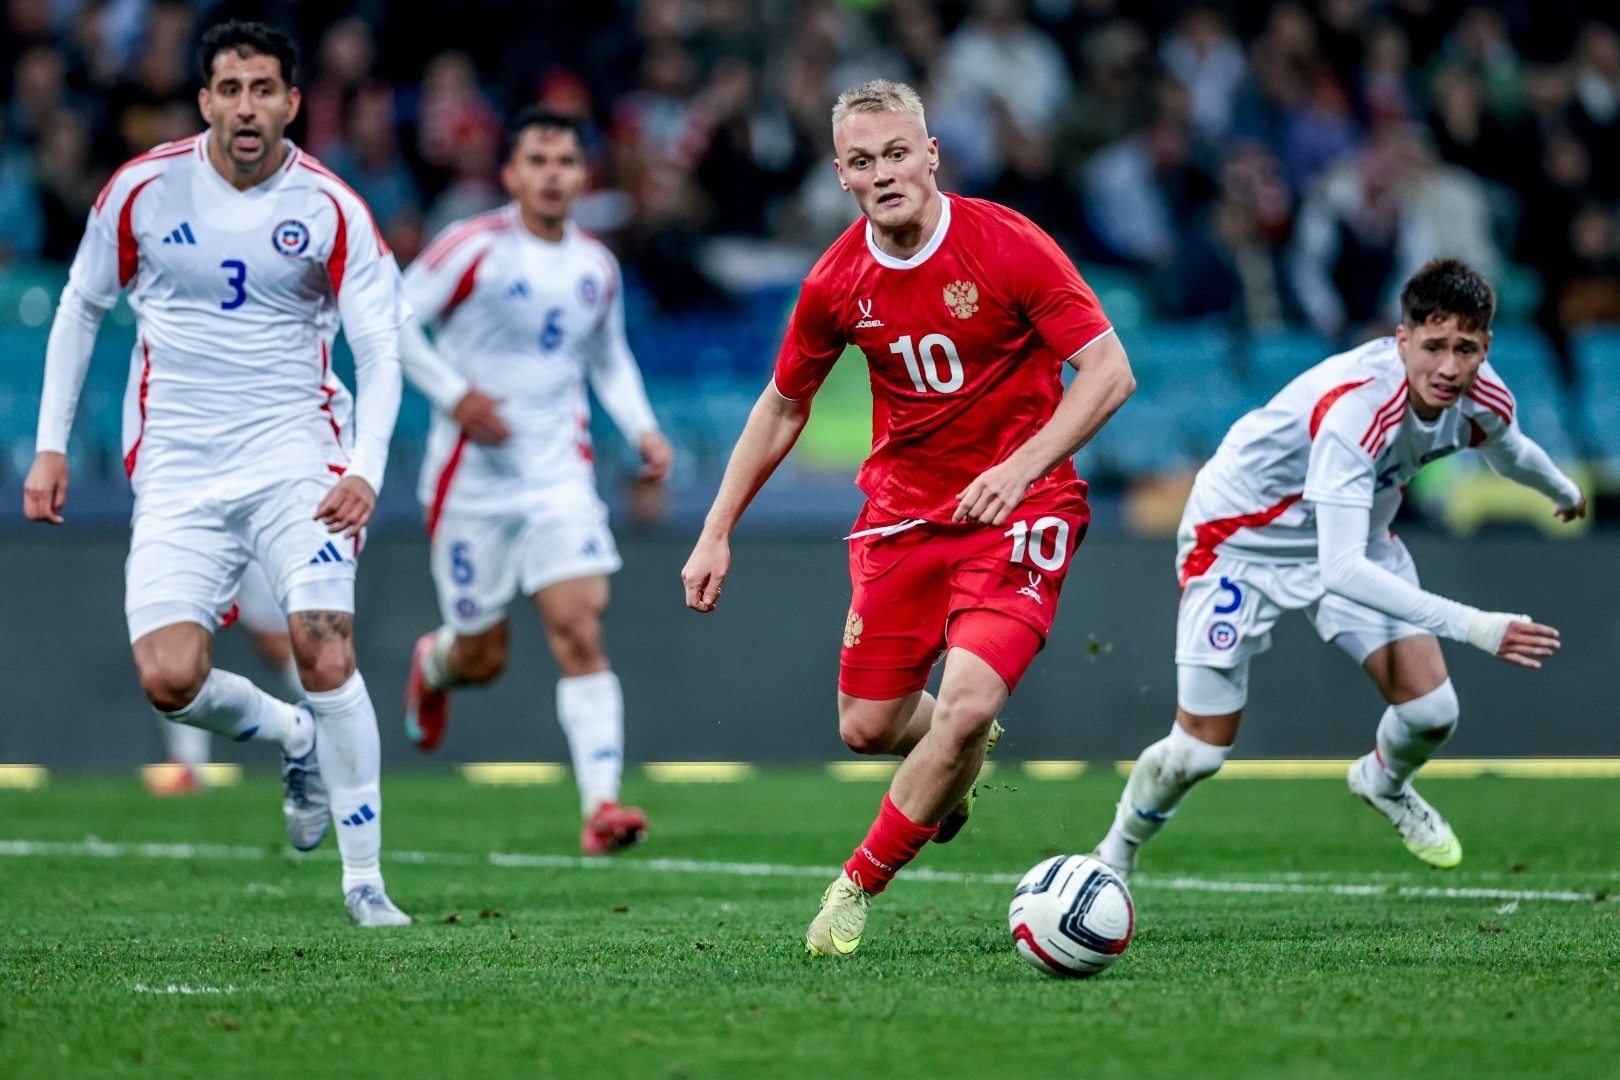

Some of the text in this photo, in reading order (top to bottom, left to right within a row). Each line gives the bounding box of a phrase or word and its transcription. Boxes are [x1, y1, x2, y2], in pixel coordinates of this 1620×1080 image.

[221, 259, 247, 310] 3
[540, 306, 566, 354] 6
[888, 333, 964, 393] 10
[450, 541, 475, 587] 6
[1003, 516, 1069, 571] 10
